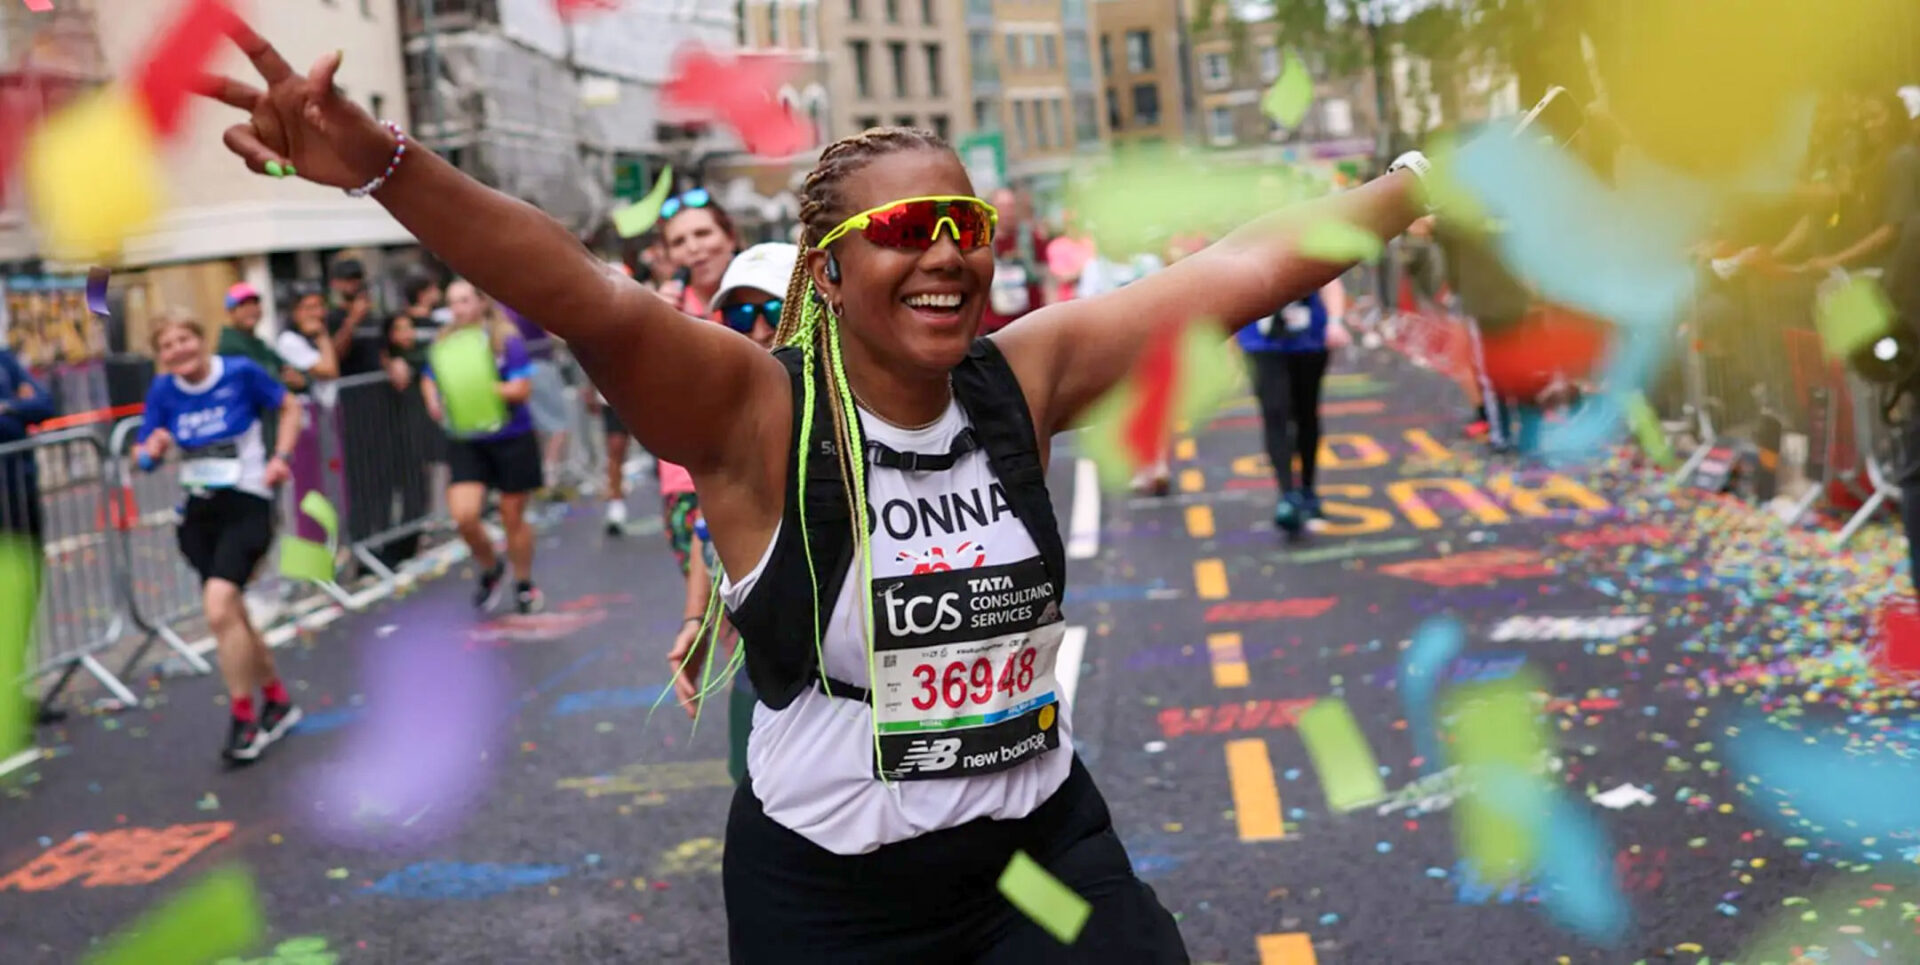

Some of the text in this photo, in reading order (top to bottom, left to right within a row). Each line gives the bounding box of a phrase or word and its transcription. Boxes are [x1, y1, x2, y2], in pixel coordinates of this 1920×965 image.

[967, 575, 1014, 594] TATA
[877, 582, 963, 637] tcs
[970, 605, 1033, 629] SERVICES
[911, 647, 1037, 711] 36948
[963, 750, 998, 769] new
